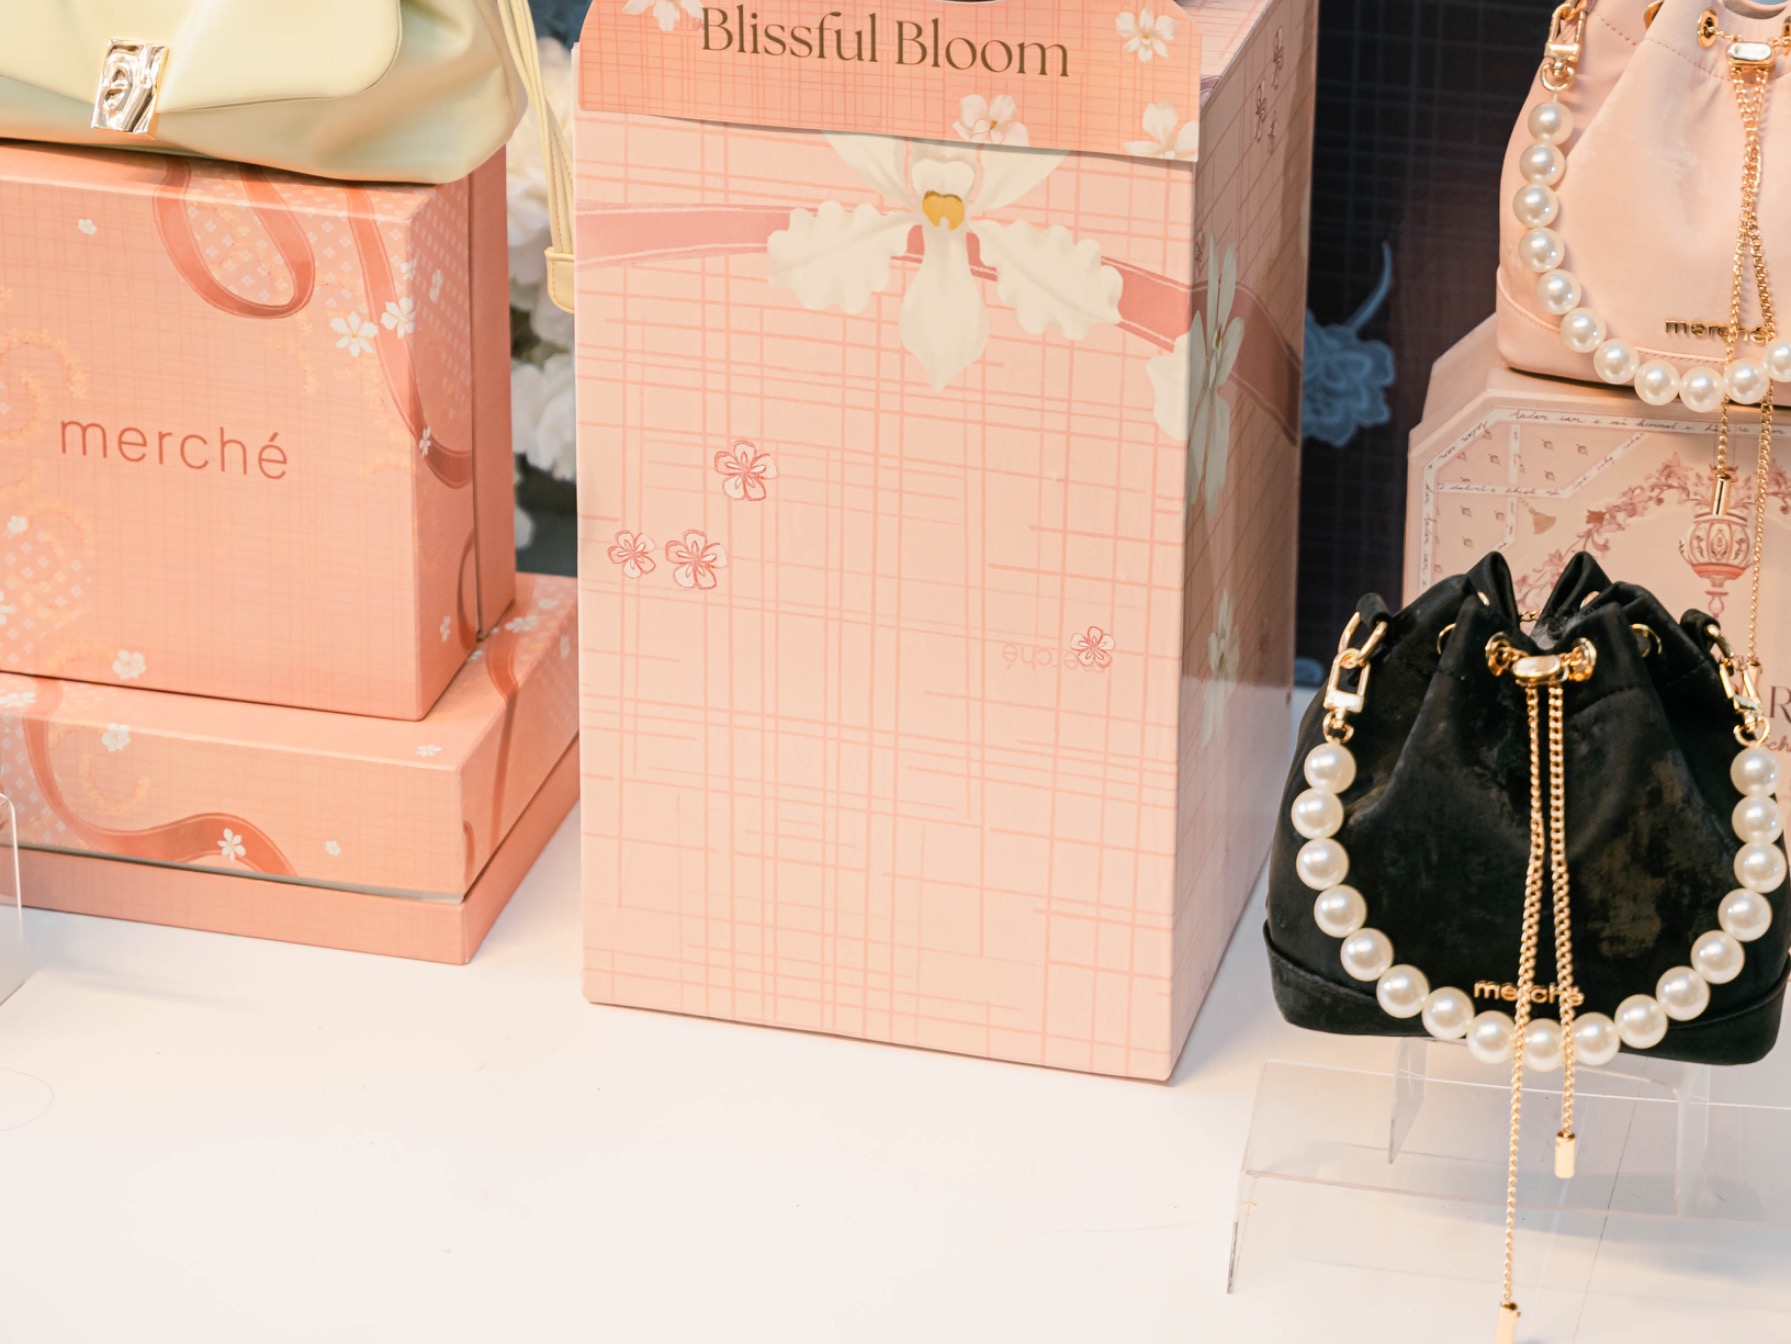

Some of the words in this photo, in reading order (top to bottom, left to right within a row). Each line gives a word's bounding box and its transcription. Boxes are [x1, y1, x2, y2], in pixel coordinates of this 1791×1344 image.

[701, 4, 878, 64] Blissful
[895, 17, 1070, 78] Bloom
[61, 420, 288, 480] merché
[1474, 980, 1585, 1007] meché
